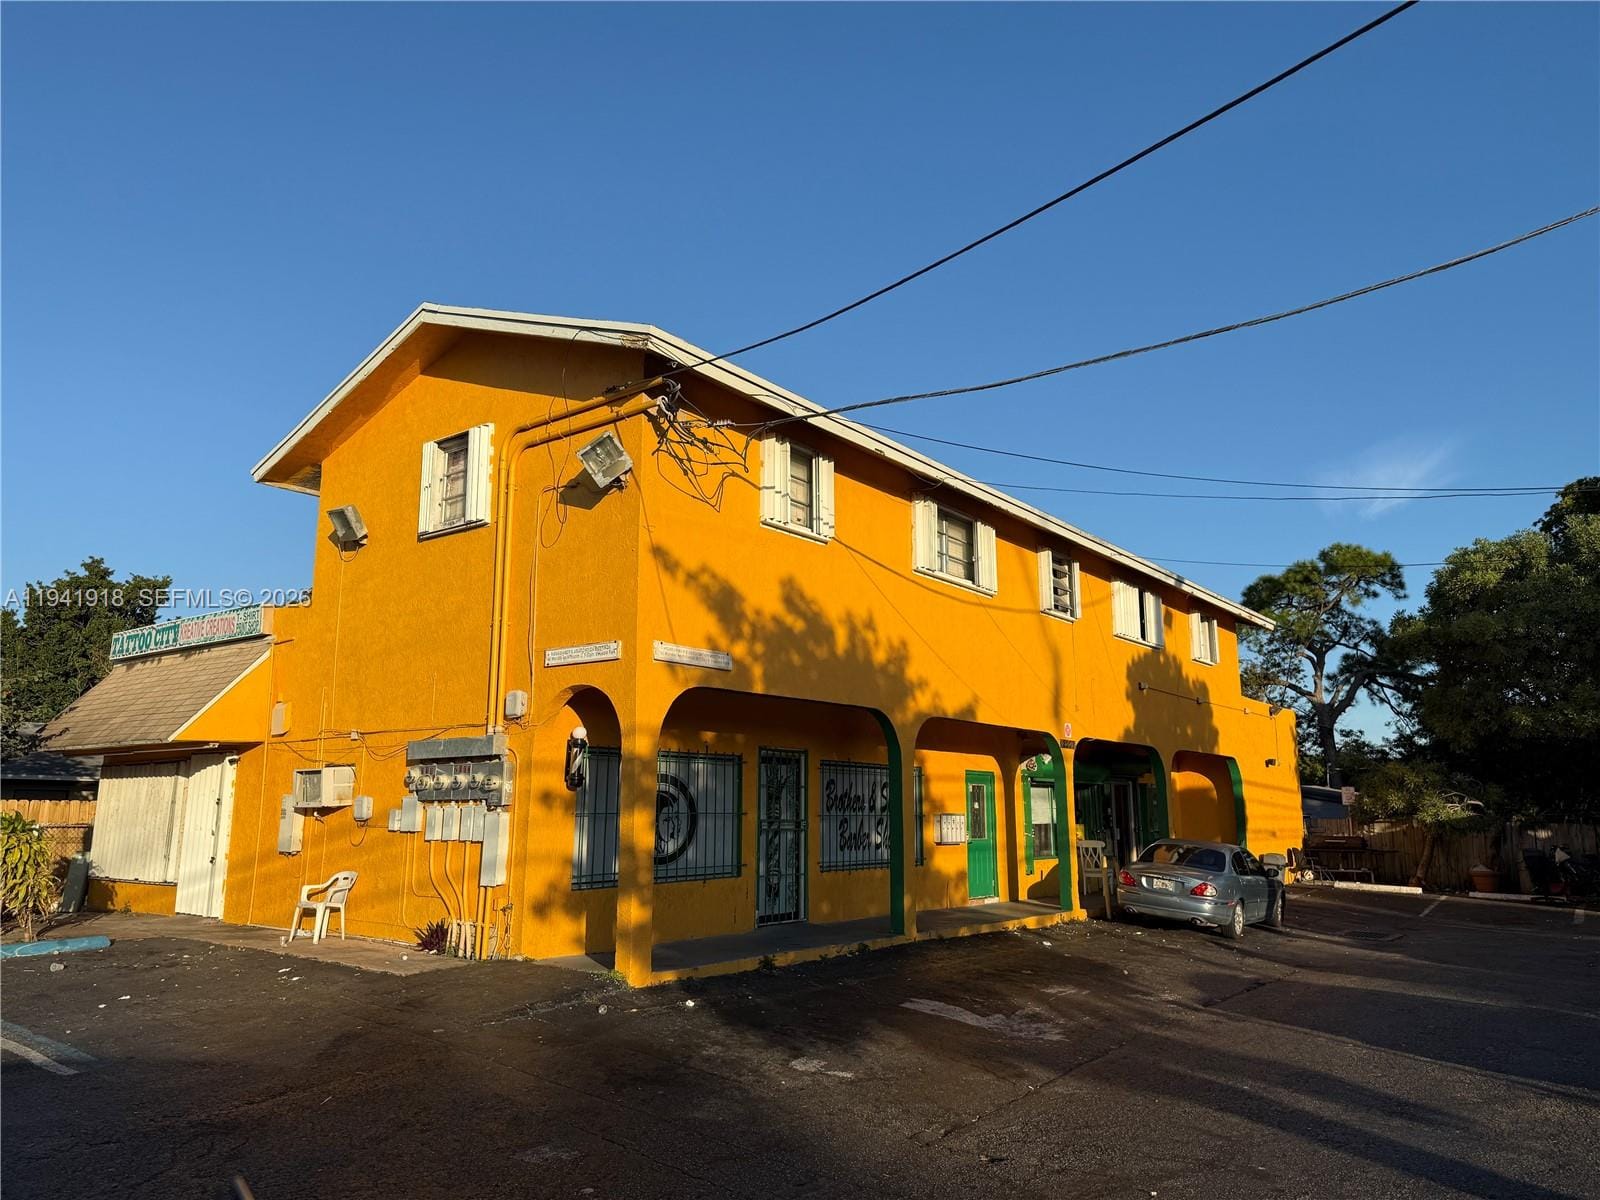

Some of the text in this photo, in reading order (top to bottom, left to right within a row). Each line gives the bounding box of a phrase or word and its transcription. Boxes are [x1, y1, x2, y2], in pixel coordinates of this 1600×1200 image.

[112, 623, 180, 656] TATTOO CITY
[181, 615, 236, 640] KREATIVE CREATIONS
[825, 779, 866, 813] Brothers
[839, 817, 872, 851] Barber
